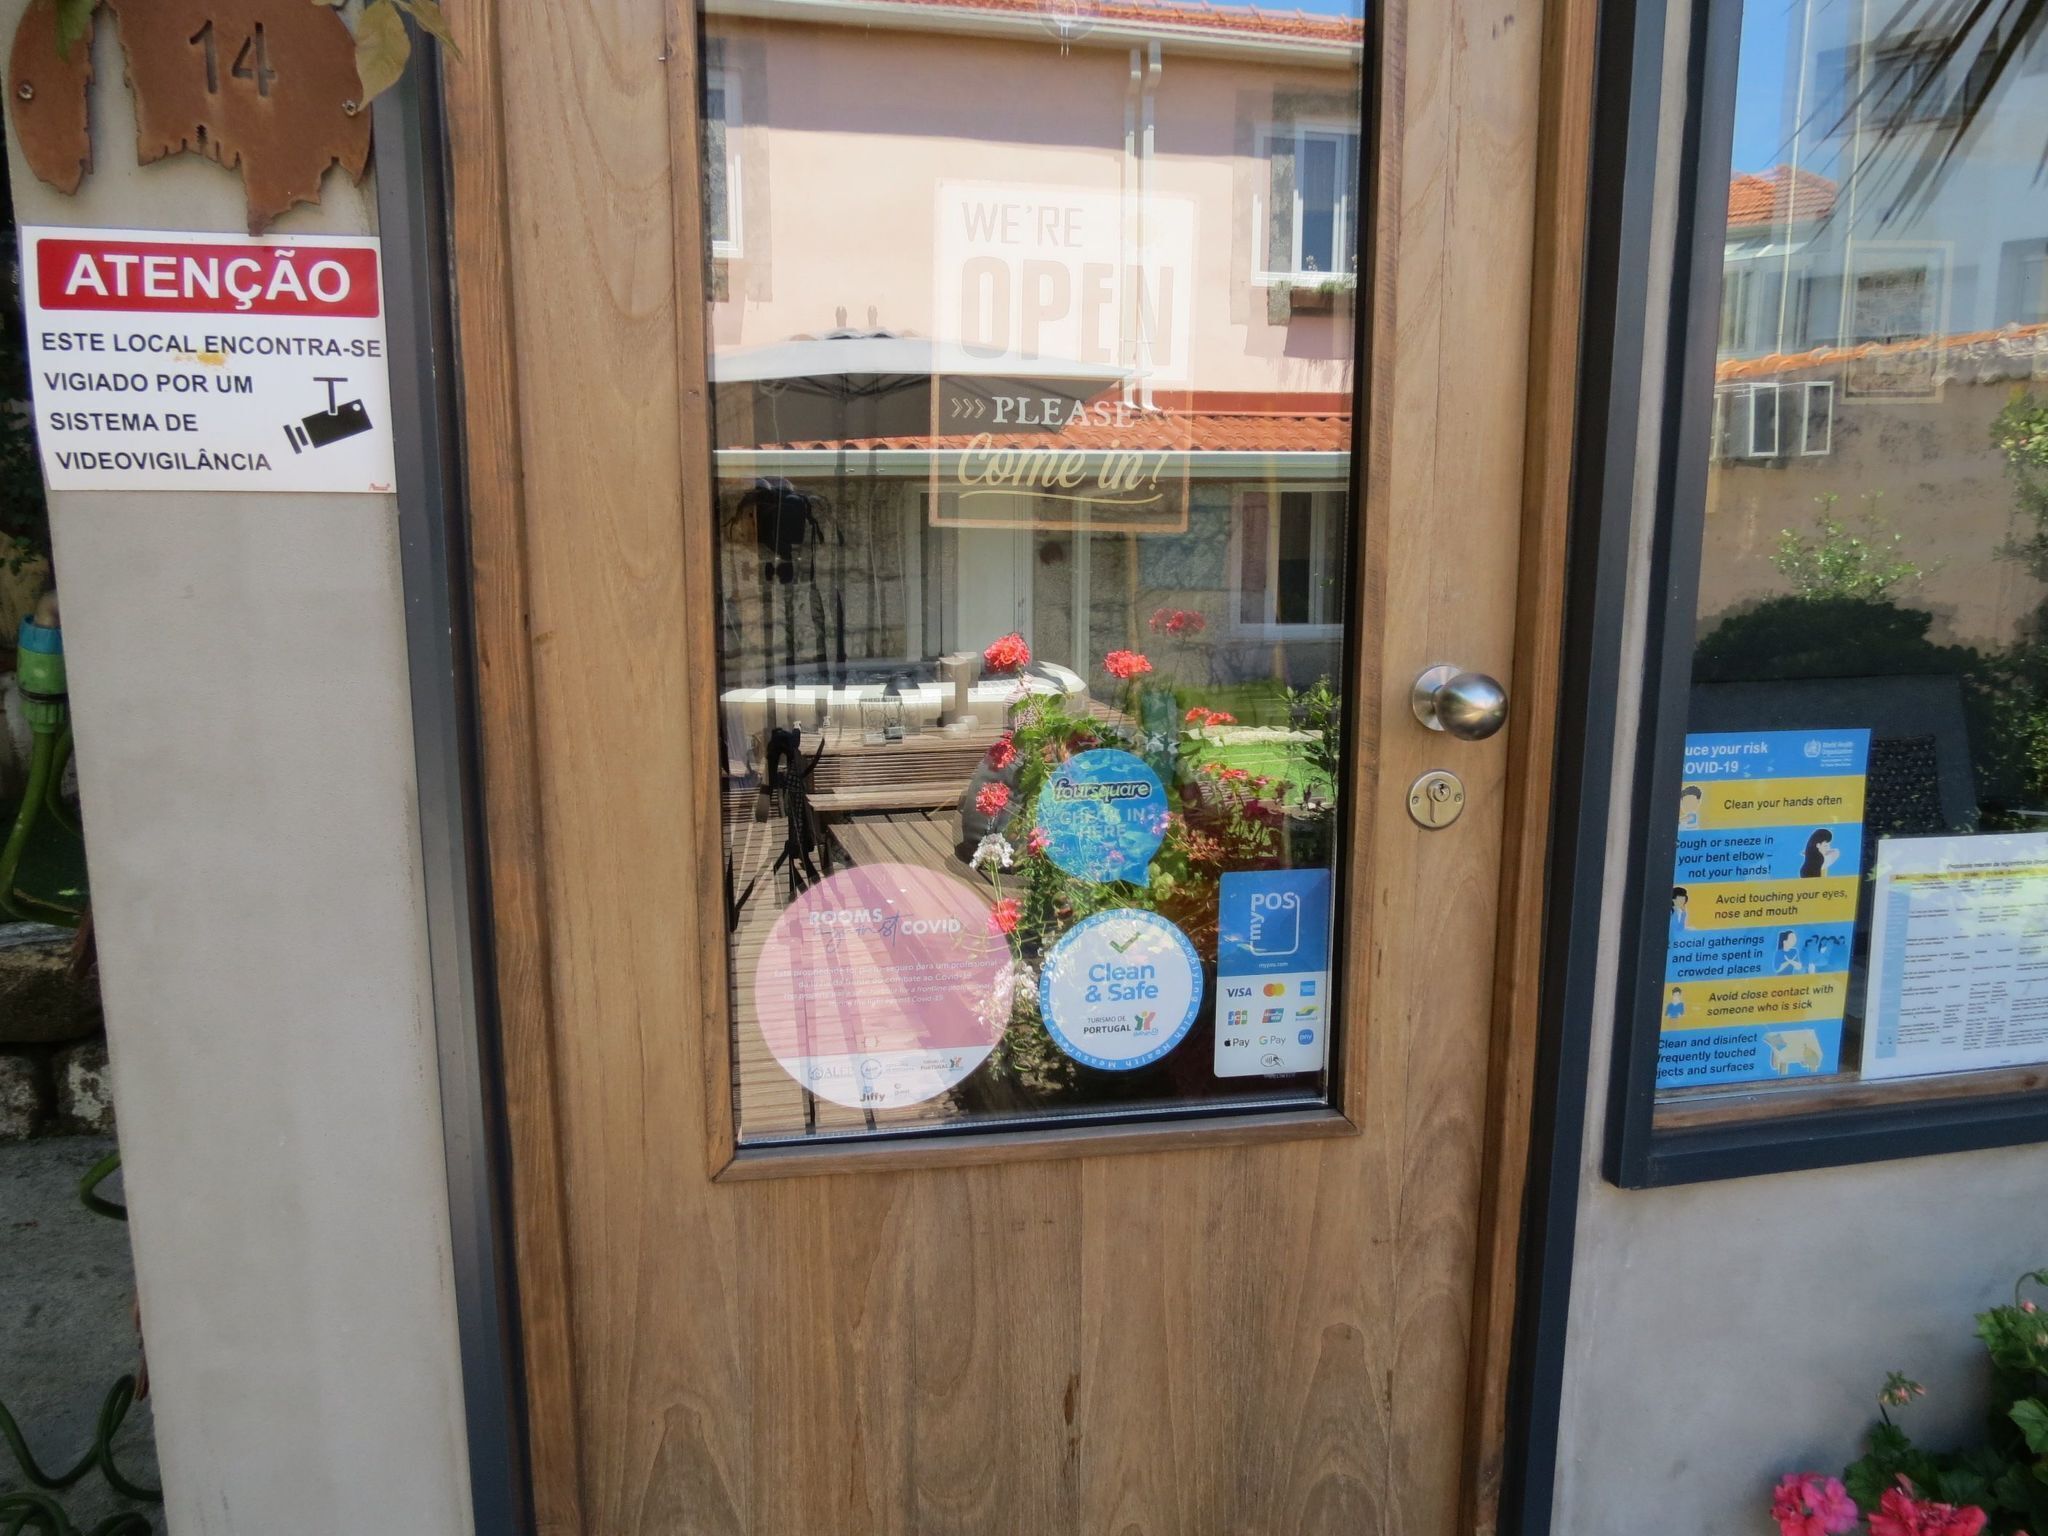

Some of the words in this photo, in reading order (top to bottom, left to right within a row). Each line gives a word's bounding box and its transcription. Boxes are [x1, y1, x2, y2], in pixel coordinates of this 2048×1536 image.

[190, 20, 275, 97] 14
[65, 248, 351, 310] ATENÇÃO
[961, 255, 1175, 366] OPEN
[42, 332, 105, 352] ESTE
[114, 333, 197, 354] LOCAL
[204, 336, 382, 358] ENCONTRA-SE
[44, 373, 148, 393] VIGIADO
[157, 374, 208, 394] POR
[216, 376, 254, 394] UM
[991, 396, 1135, 428] PLEASE
[50, 412, 158, 432] SISTEMA
[167, 413, 199, 432] DE
[56, 449, 271, 472] VIDEOVIGILÂNCIA
[957, 432, 1087, 488] Come
[1098, 439, 1168, 491] in!
[1685, 745, 1709, 756] uce
[1711, 745, 1741, 758] your
[1744, 741, 1768, 754] risk
[1683, 761, 1739, 774] OVID-19
[1055, 778, 1150, 803] foursquare
[1724, 799, 1754, 810] Clean
[1756, 800, 1780, 812] your
[1783, 796, 1814, 808] hands
[1816, 795, 1843, 805] often
[1675, 837, 1707, 850] Cough
[1712, 839, 1721, 848] or
[1724, 838, 1761, 847] sneeze
[1764, 835, 1774, 845] in
[1678, 851, 1704, 867] your
[1706, 851, 1730, 863] bent
[1732, 850, 1765, 861] elbow
[1688, 867, 1706, 879] not
[1708, 867, 1733, 881] your
[1735, 864, 1772, 876] hands!
[1716, 893, 1746, 905] Avoid
[1748, 891, 1794, 905] touching
[1795, 889, 1820, 903] your
[1821, 889, 1848, 901] eyes,
[809, 908, 883, 926] ROOMS
[1714, 910, 1740, 920] nose
[1743, 907, 1763, 918] and
[1765, 905, 1798, 917] mouth
[901, 919, 961, 935] COVID
[1673, 937, 1705, 949] social
[1707, 934, 1765, 949] gatherings
[1672, 952, 1693, 964] and
[1695, 950, 1719, 962] time
[1721, 948, 1750, 963] spent
[1753, 948, 1763, 958] in
[1089, 963, 1155, 983] Clean
[1677, 966, 1724, 979] crowded
[1727, 964, 1762, 977] places
[1085, 984, 1101, 1003] &
[1108, 981, 1159, 1001] Safe
[1227, 987, 1252, 997] VISA
[1708, 991, 1738, 1003] Avoid
[1740, 990, 1768, 1001] close
[1771, 987, 1810, 999] contact
[1812, 984, 1834, 995] with
[1707, 1005, 1754, 1017] someone
[1757, 1002, 1778, 1013] who
[1781, 1001, 1789, 1011] is
[1792, 1000, 1813, 1010] sick
[1083, 1024, 1131, 1034] PORTUGAL
[1232, 1038, 1250, 1048] Pay
[1270, 1035, 1286, 1046] Pay
[1658, 1039, 1687, 1049] Clean
[1690, 1036, 1711, 1047] and
[1713, 1033, 1758, 1045] disinfect
[1657, 1050, 1711, 1064] frequently
[1714, 1047, 1757, 1059] touched
[1656, 1065, 1684, 1079] jects
[1687, 1063, 1708, 1075] and
[1710, 1061, 1755, 1074] surfaces
[860, 1091, 886, 1103] Jiffy
